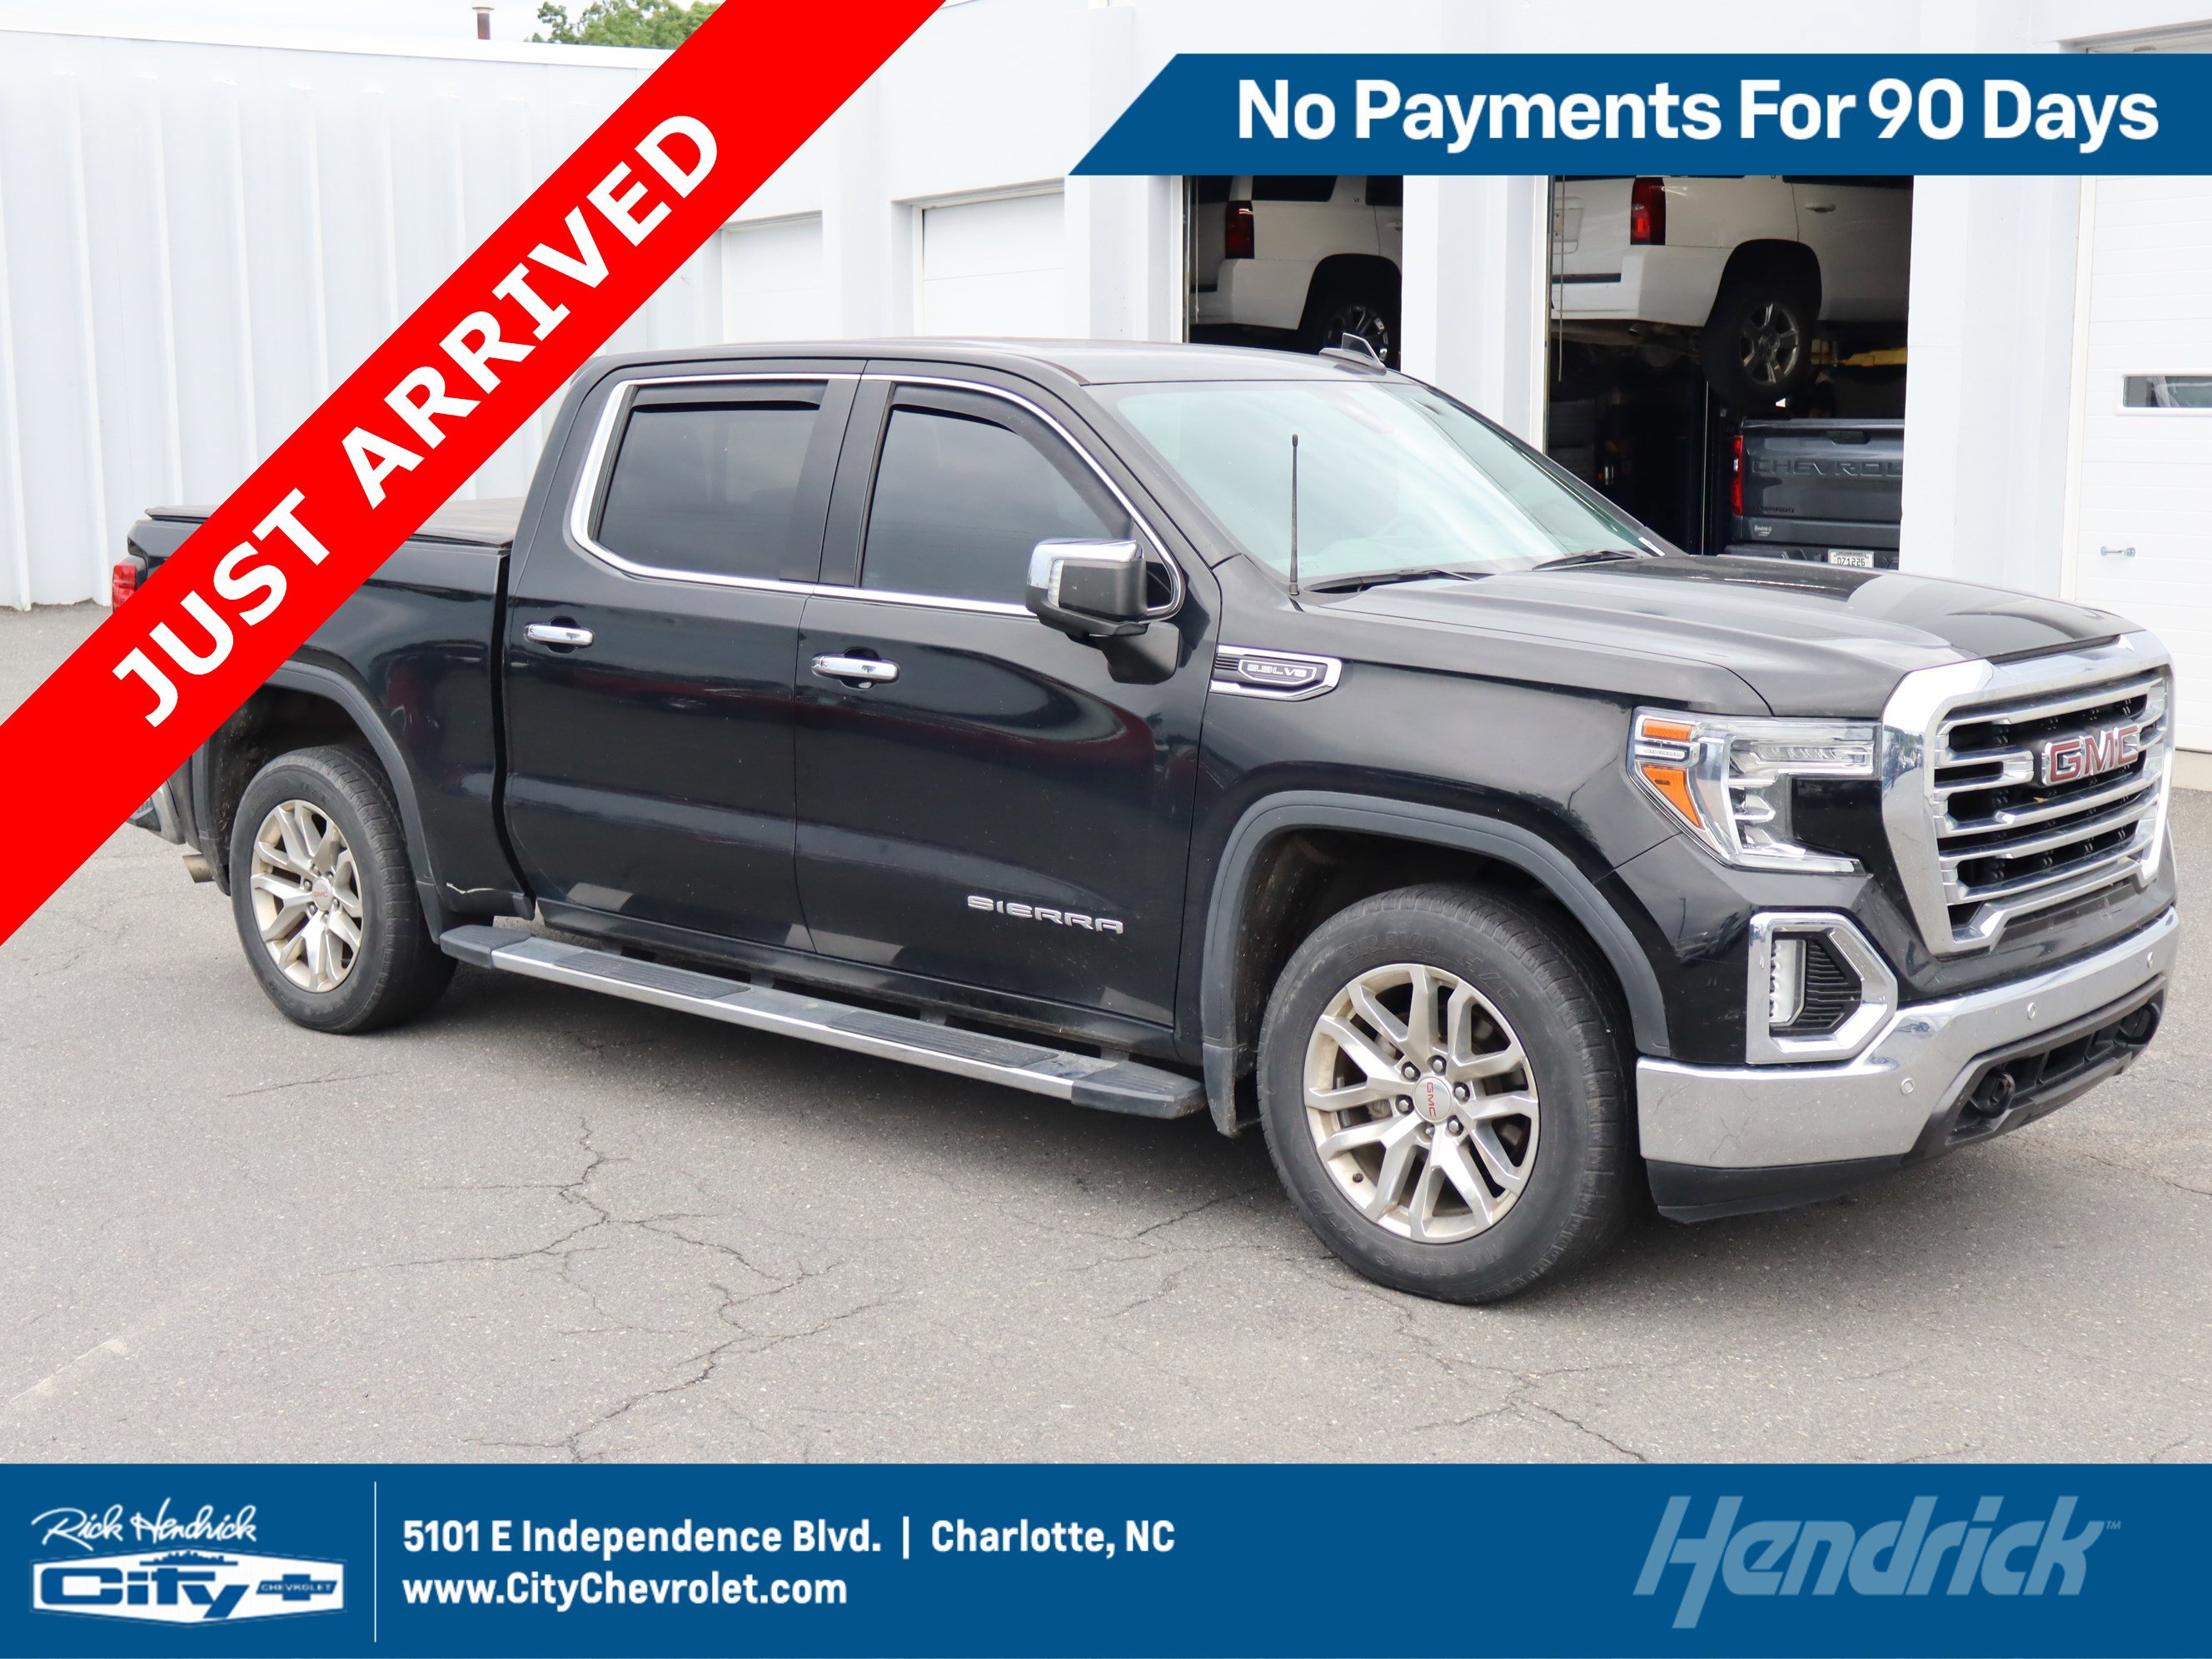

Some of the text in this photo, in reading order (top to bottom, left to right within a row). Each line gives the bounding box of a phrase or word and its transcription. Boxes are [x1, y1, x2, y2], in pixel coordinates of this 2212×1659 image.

[2043, 723, 2140, 786] GMC
[967, 895, 1124, 935] SIERRA
[1427, 1082, 1437, 1117] GMC
